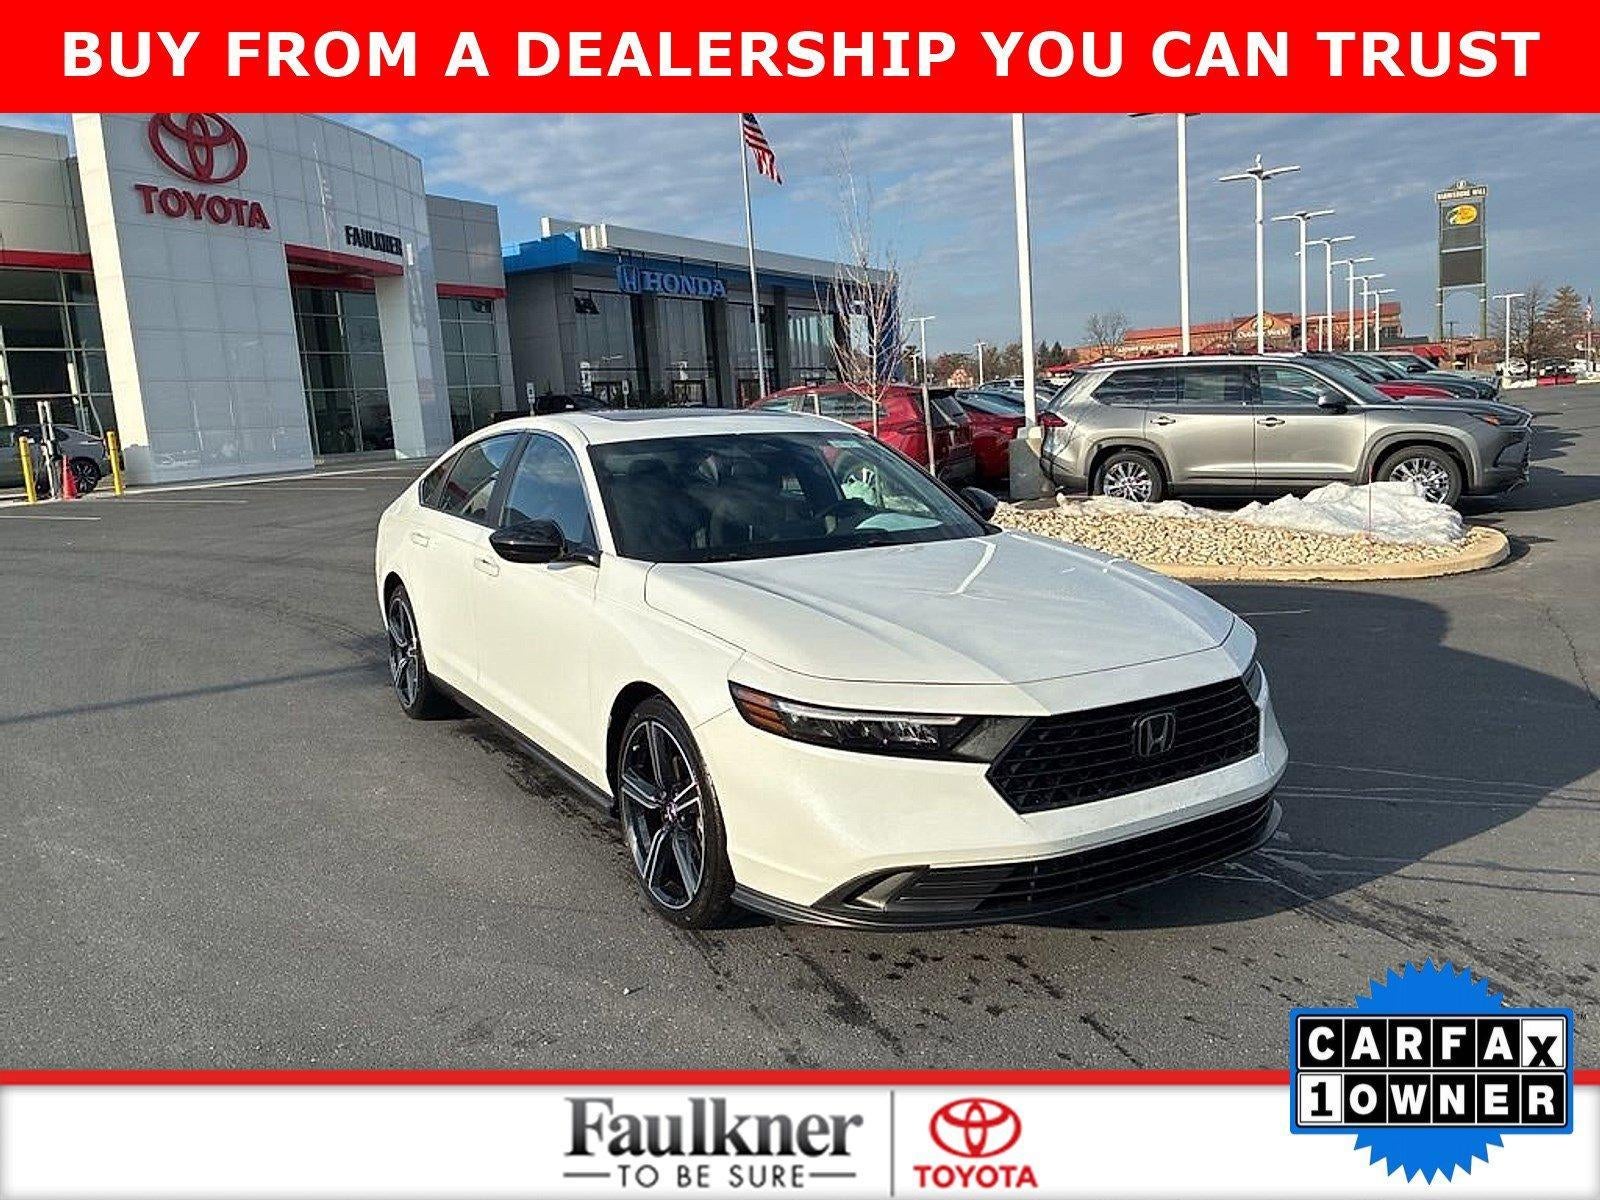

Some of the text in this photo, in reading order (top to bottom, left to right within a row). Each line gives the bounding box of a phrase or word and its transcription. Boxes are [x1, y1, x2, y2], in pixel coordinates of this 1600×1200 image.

[134, 184, 270, 230] TOYOTA
[345, 225, 403, 257] FAULKNER
[641, 271, 726, 298] HONDA
